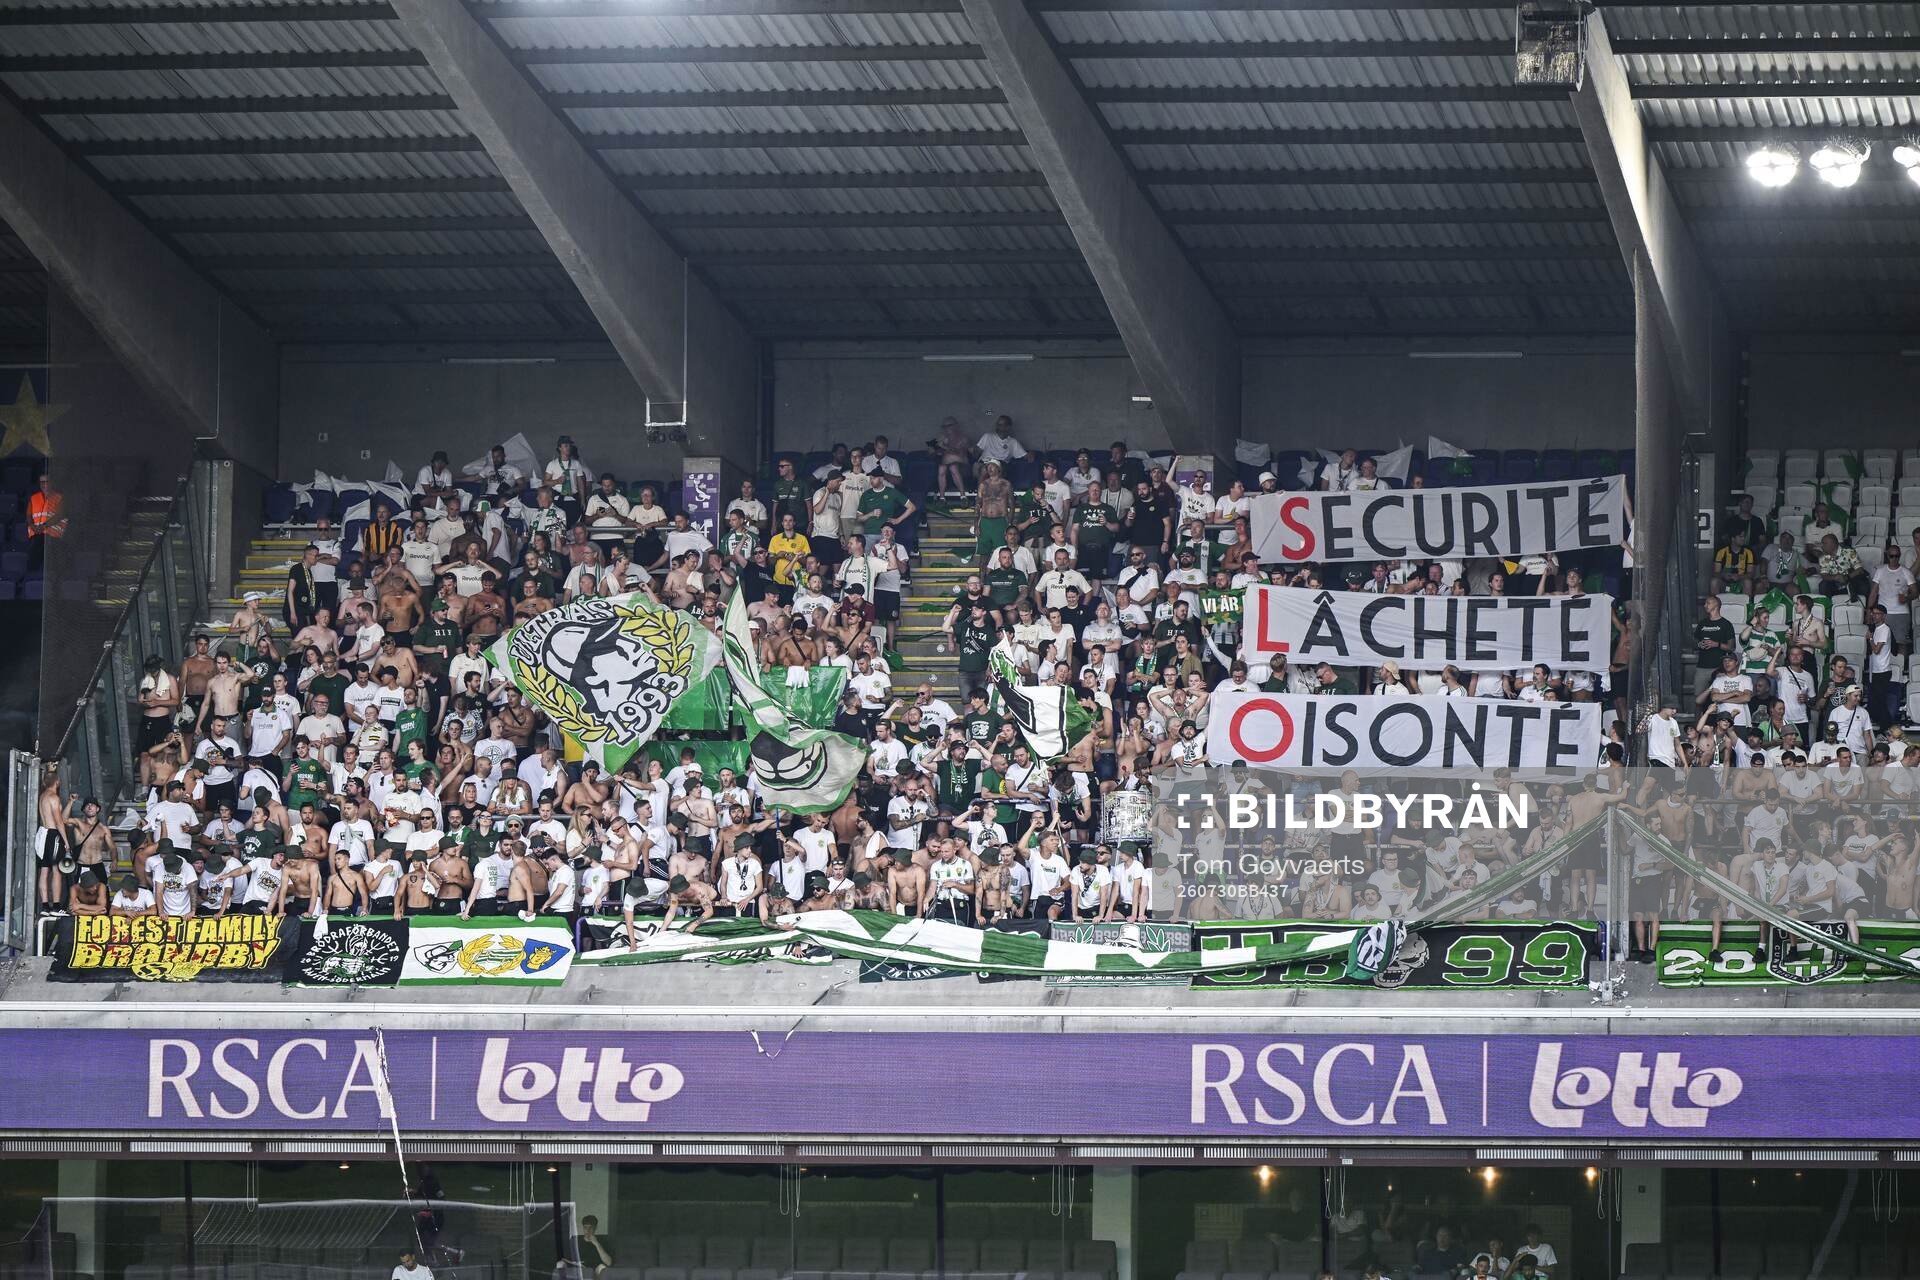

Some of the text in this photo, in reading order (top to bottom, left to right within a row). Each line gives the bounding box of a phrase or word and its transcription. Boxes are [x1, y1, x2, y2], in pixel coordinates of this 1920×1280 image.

[1280, 478, 1610, 560] SECURITÉ
[509, 600, 616, 667] ULTRAS
[1202, 597, 1217, 614] VI
[1220, 595, 1239, 612] ÄR
[604, 672, 688, 746] 1993
[1229, 698, 1581, 776] OISONTÉ
[78, 914, 280, 943] FOREST FAMILY
[1442, 930, 1587, 985] 99
[1663, 948, 1757, 976] 20
[147, 1038, 392, 1120] RSCA
[1191, 1043, 1448, 1125] RSCA
